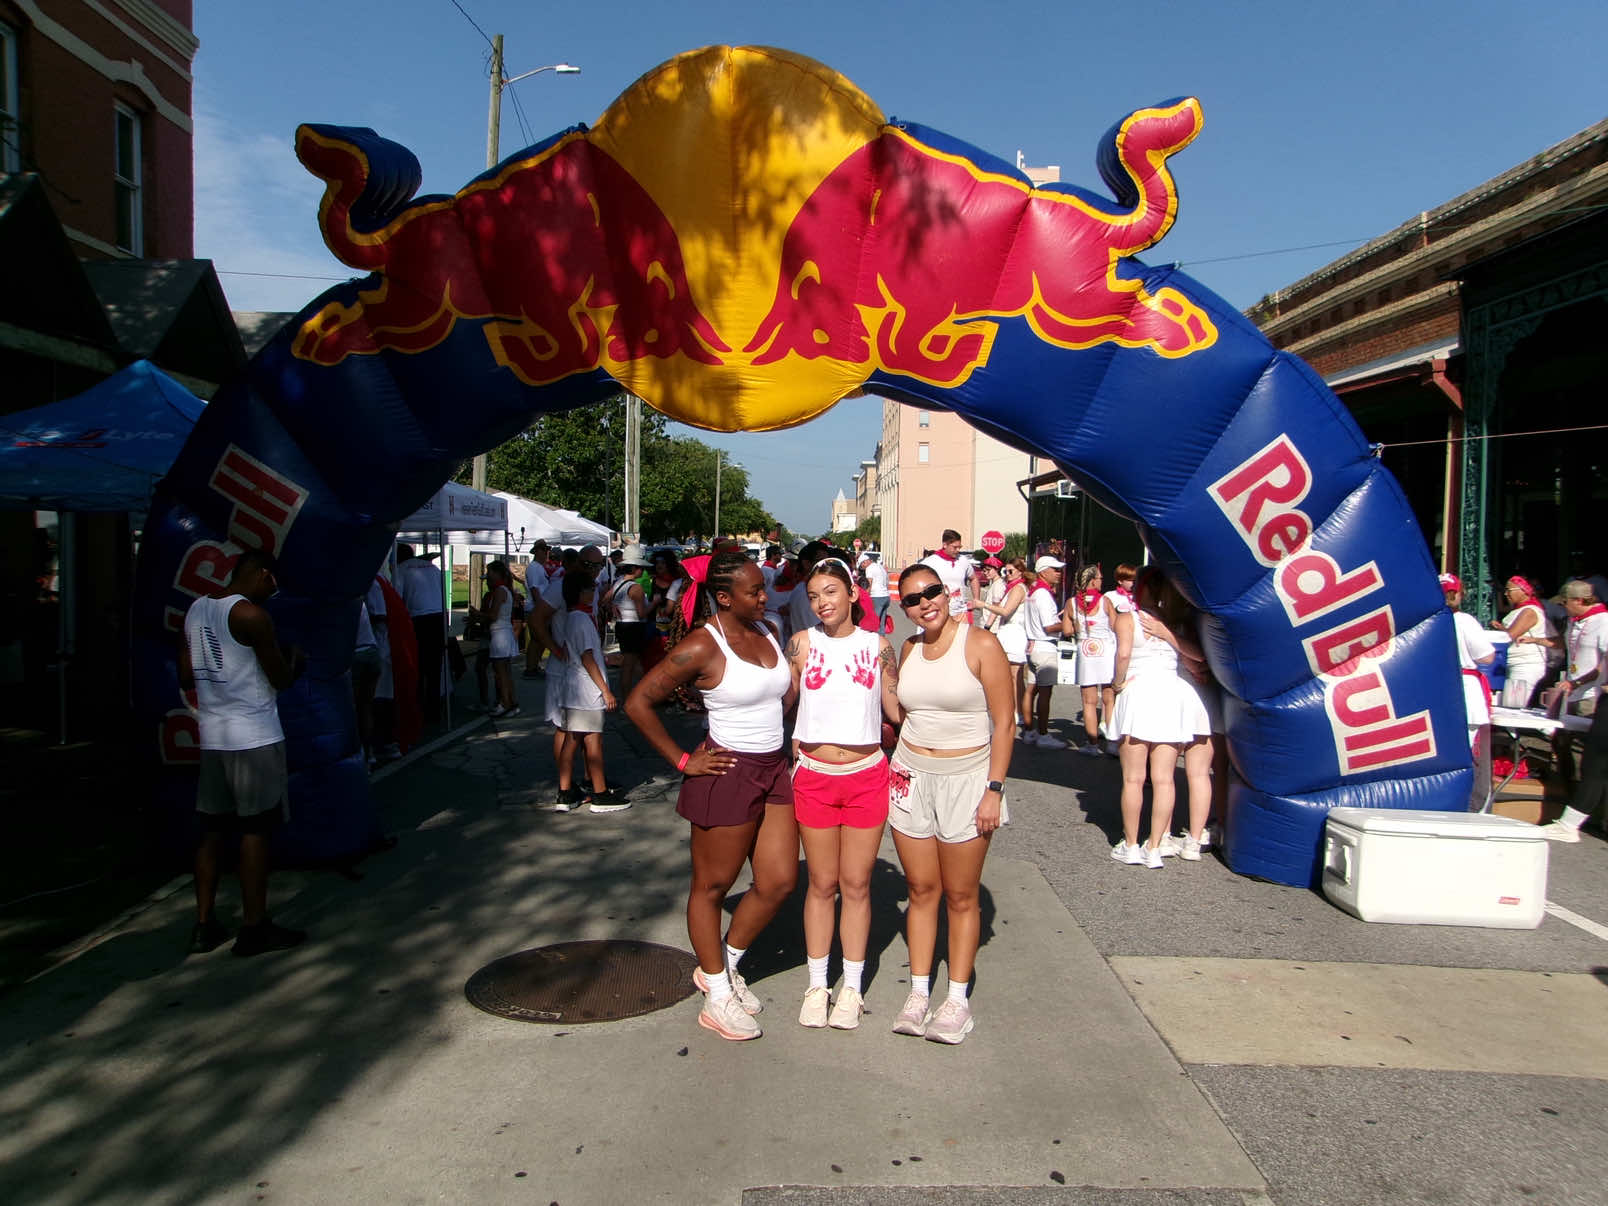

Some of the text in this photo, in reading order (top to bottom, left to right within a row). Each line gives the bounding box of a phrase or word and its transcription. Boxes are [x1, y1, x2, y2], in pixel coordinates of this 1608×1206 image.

[982, 537, 1003, 547] STOP
[1208, 435, 1435, 775] Red Bull
